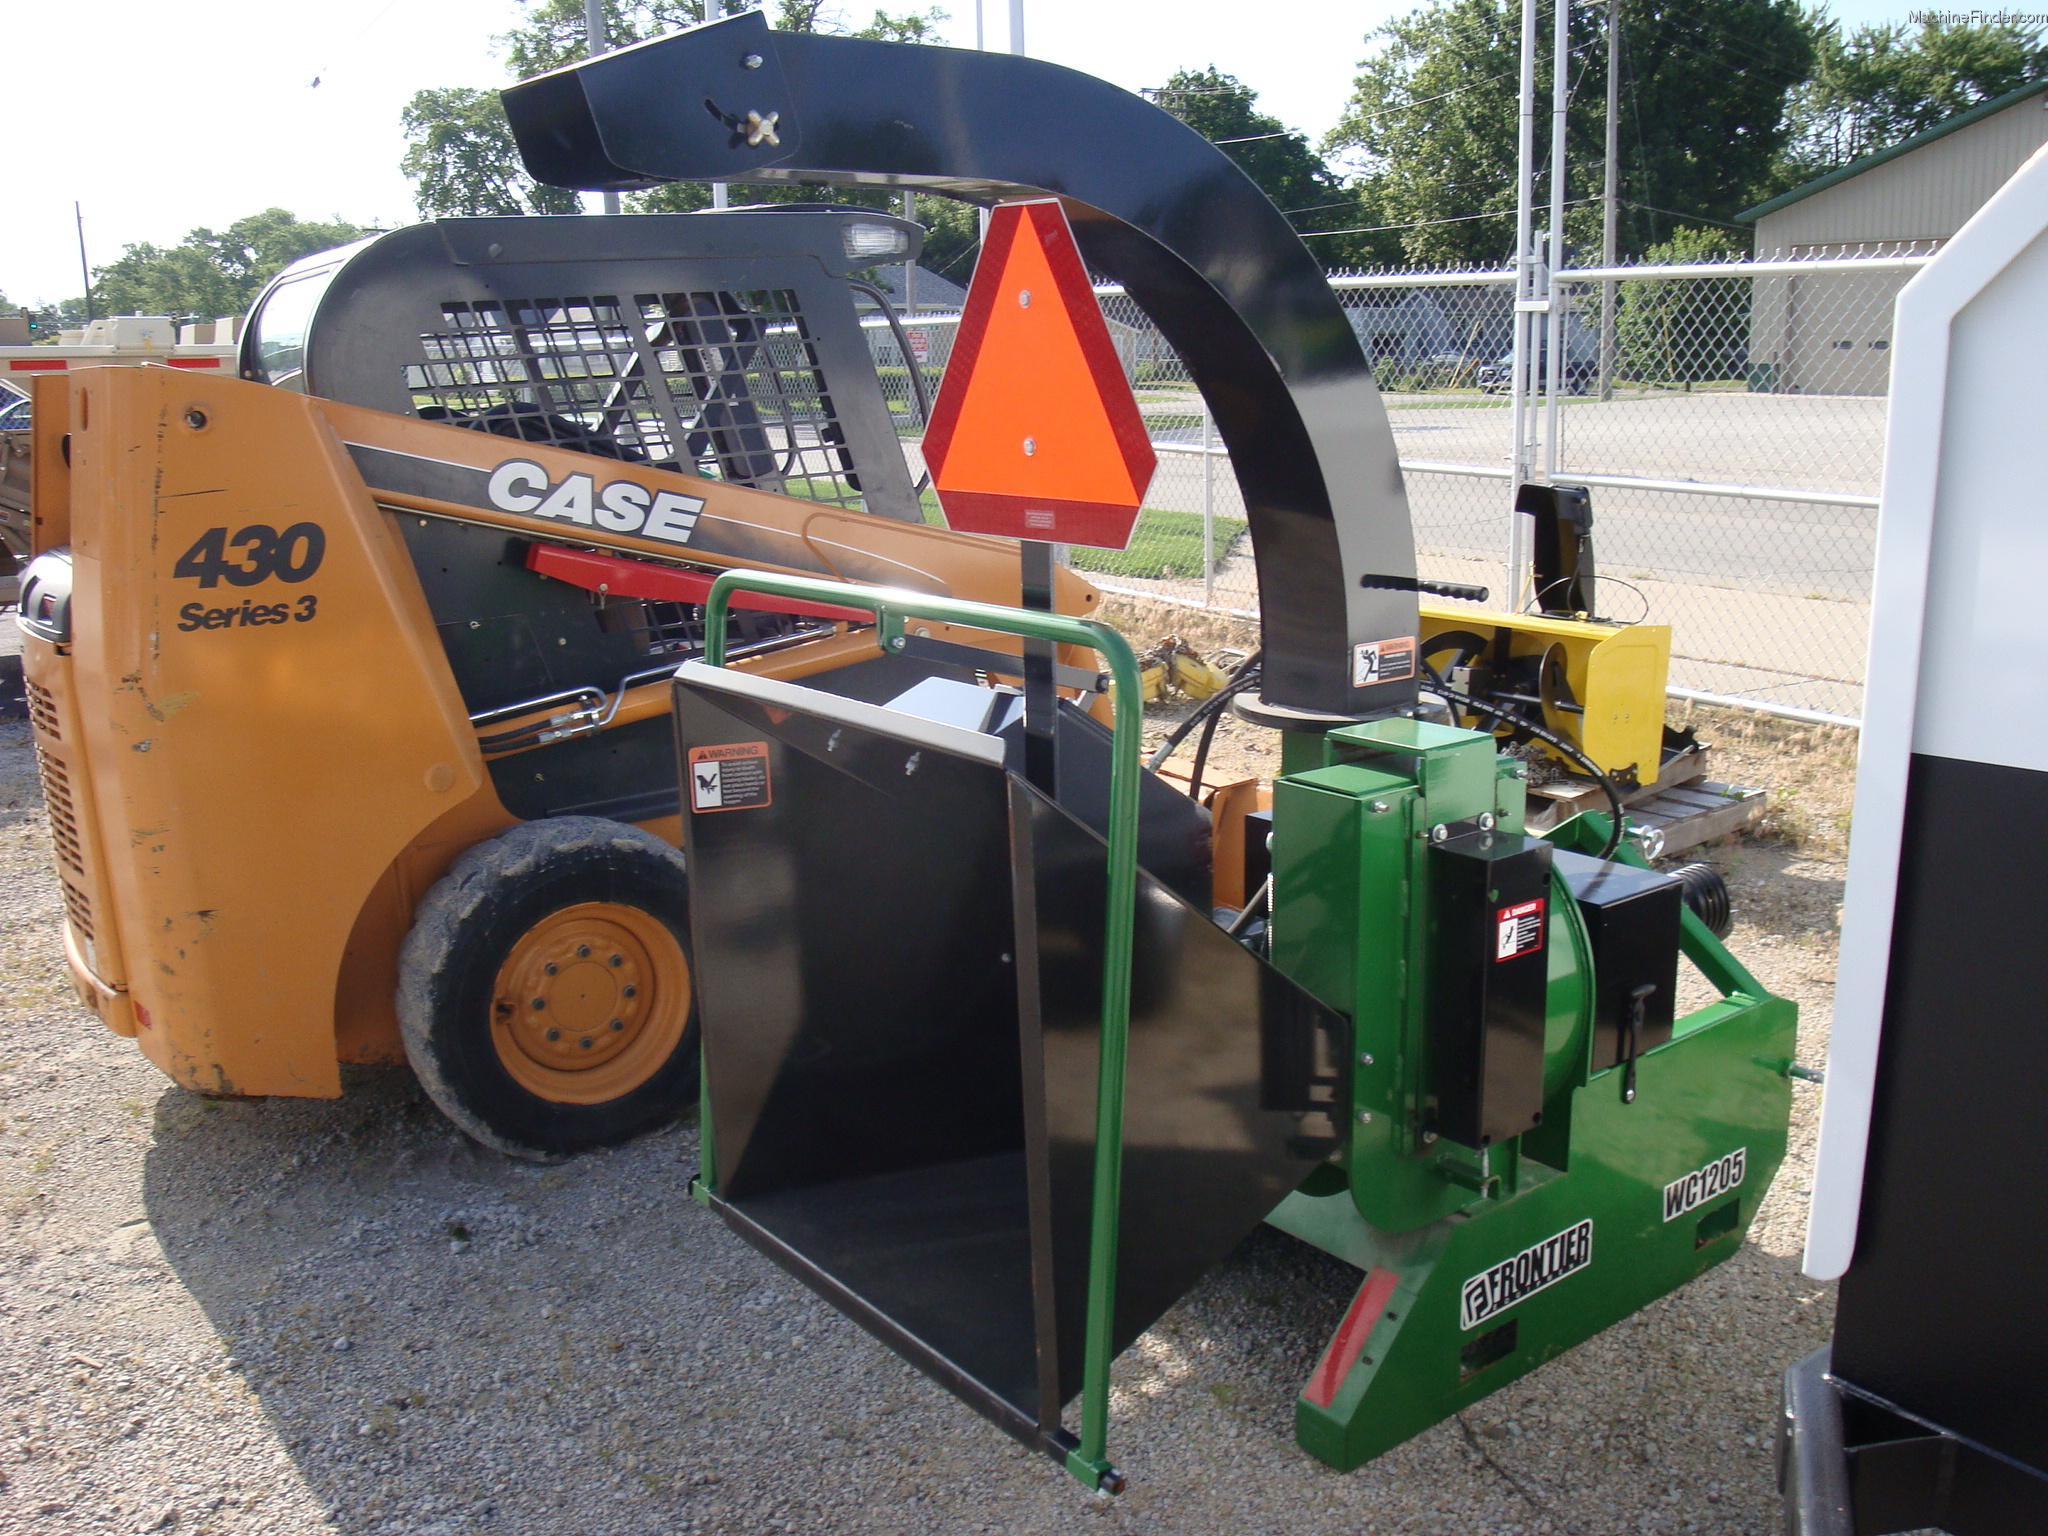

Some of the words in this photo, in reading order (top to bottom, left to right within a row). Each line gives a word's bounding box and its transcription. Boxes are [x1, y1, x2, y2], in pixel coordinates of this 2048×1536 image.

[488, 461, 705, 543] CASE
[173, 522, 326, 588] 430
[177, 599, 290, 632] Series
[294, 595, 318, 623] 3
[708, 745, 758, 758] WARNING
[1665, 1150, 1744, 1218] WC1205
[1486, 1221, 1591, 1310] FRONTIER
